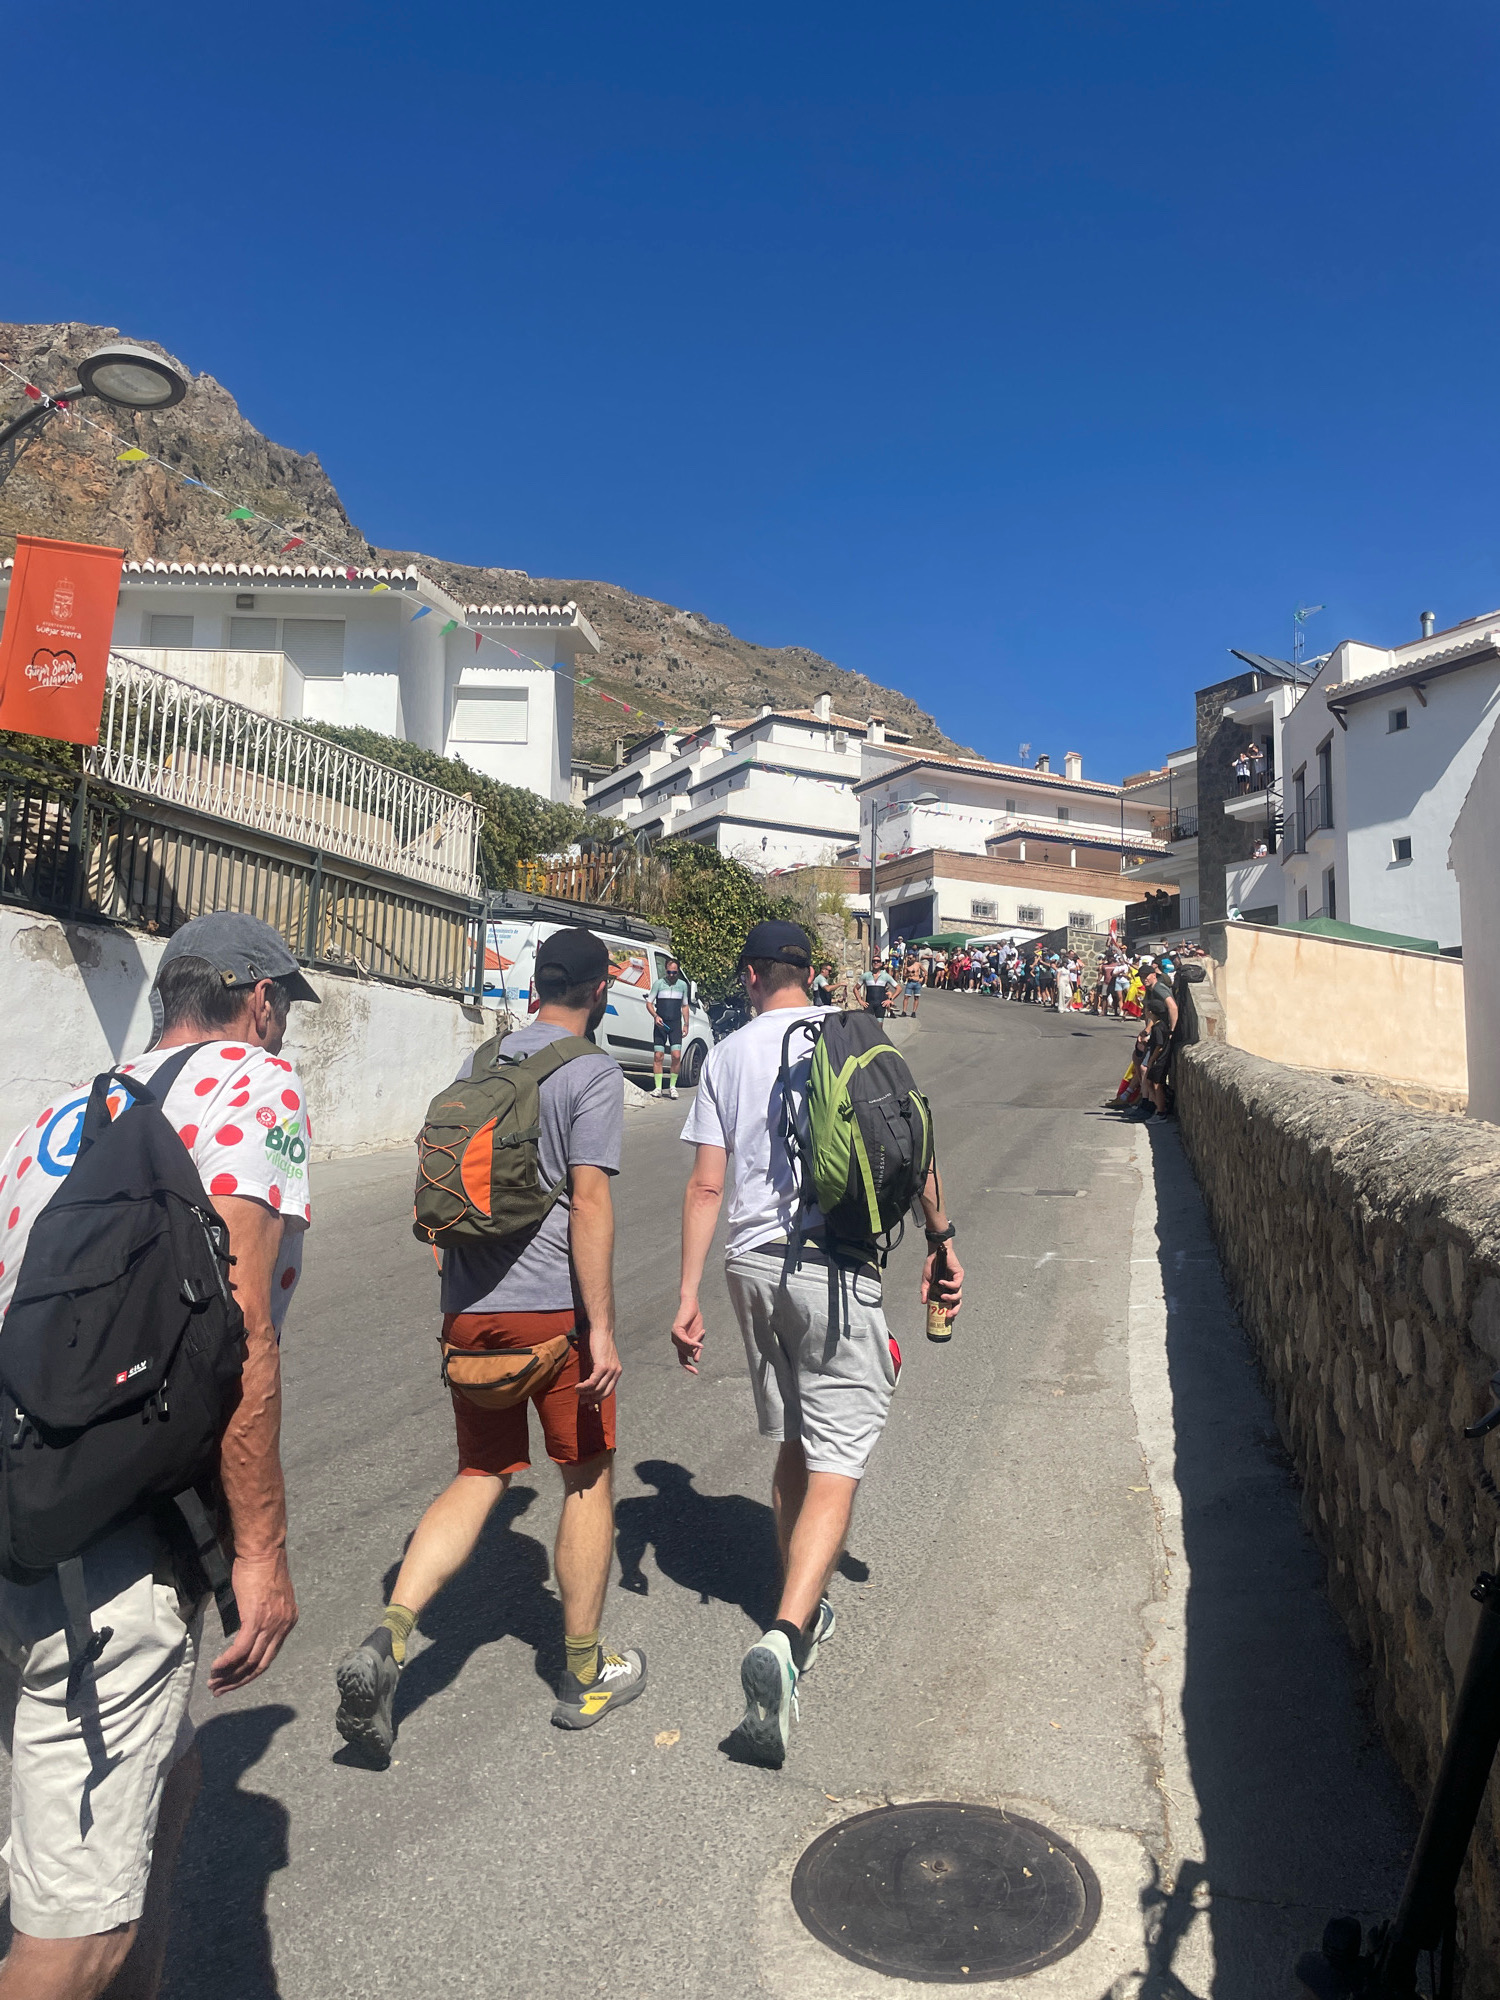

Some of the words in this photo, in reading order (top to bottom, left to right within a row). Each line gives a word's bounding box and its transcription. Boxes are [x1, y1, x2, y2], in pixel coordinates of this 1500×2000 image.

[60, 630, 82, 640] Sierra
[52, 658, 76, 676] Sierra
[265, 1125, 306, 1164] BIO
[264, 1150, 304, 1179] village
